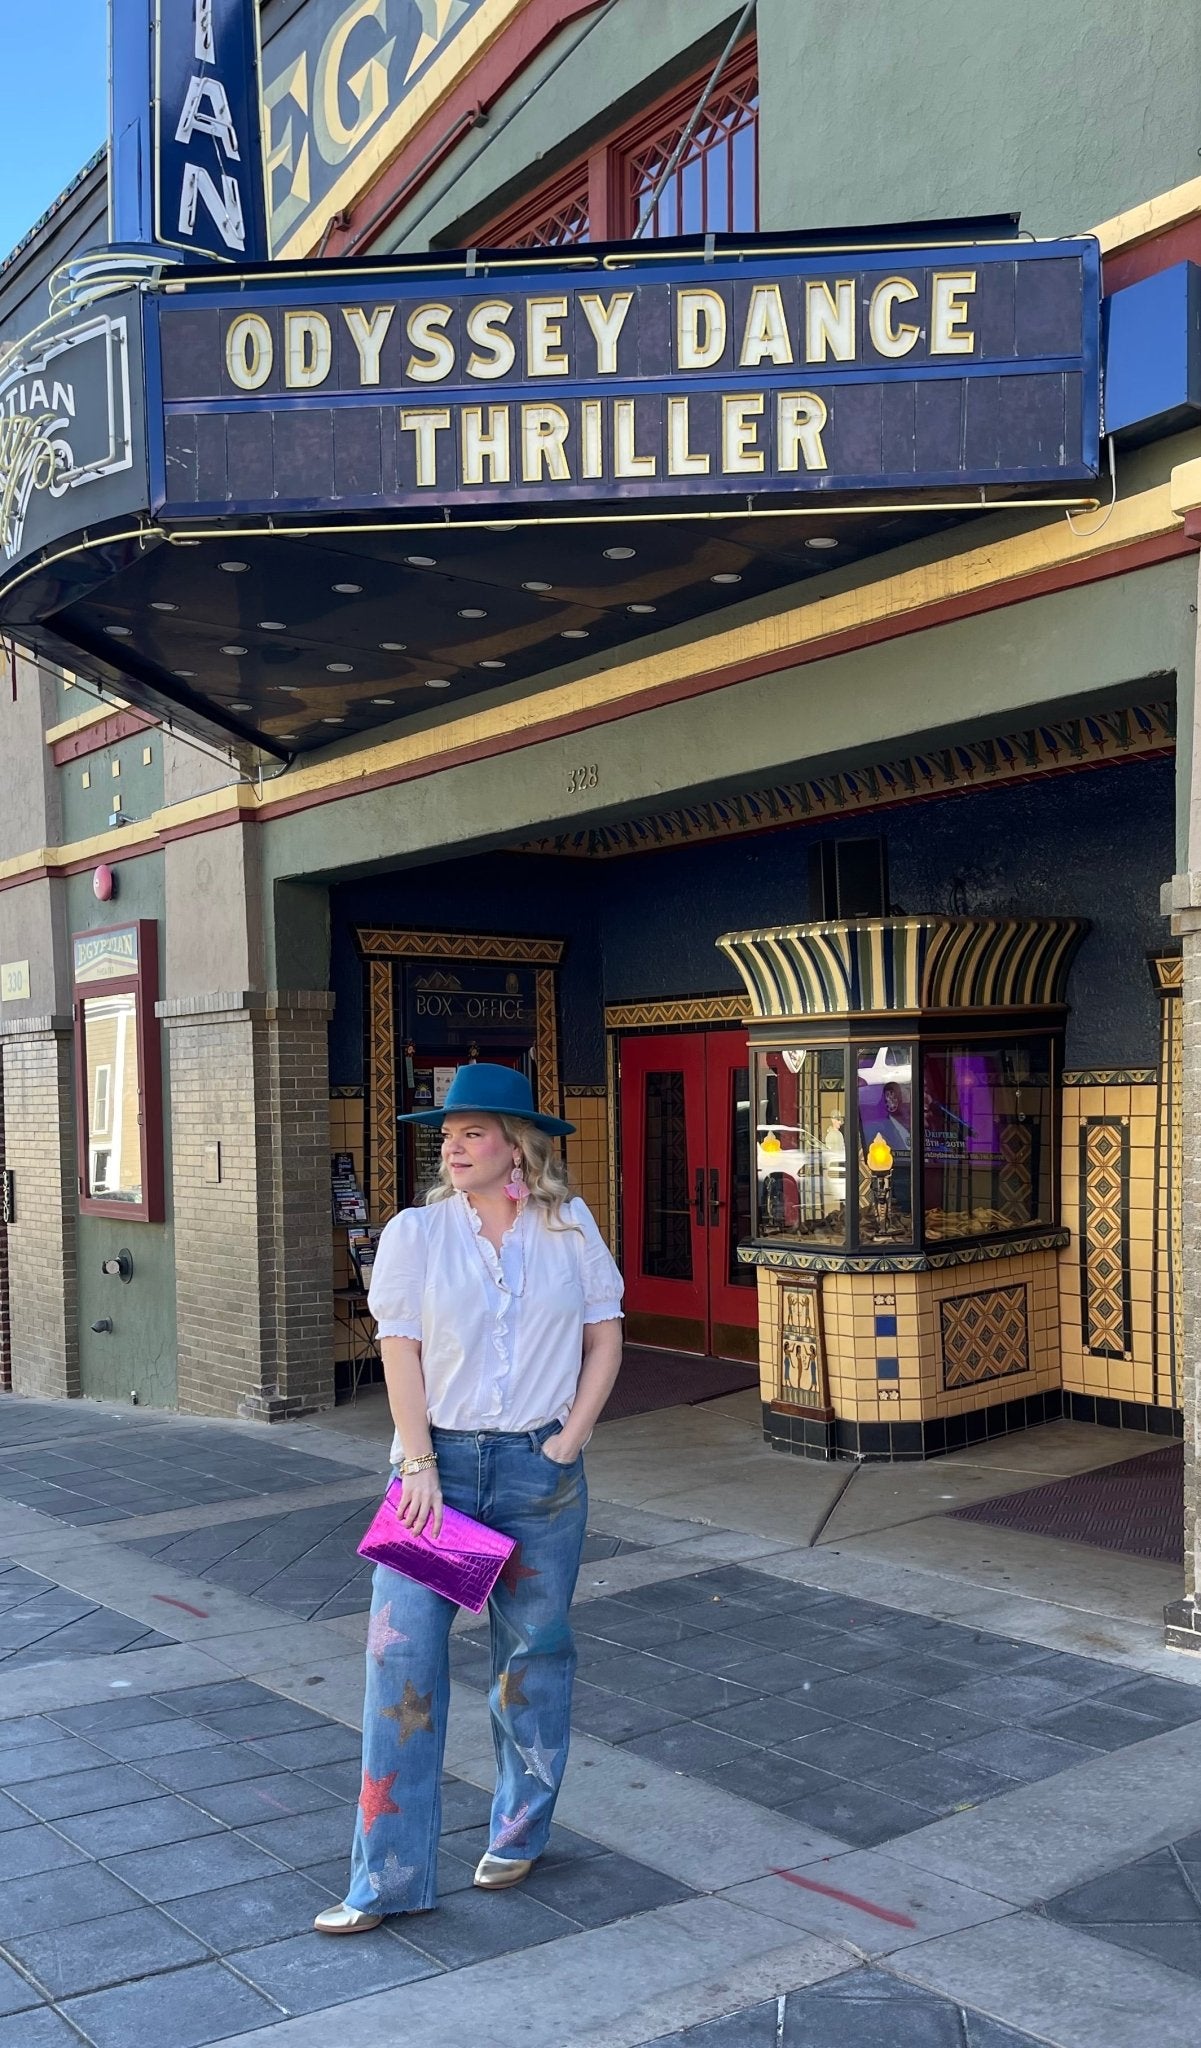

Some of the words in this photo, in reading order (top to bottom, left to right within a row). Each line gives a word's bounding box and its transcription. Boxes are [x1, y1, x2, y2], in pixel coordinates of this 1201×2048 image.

[226, 290, 634, 391] ODYSSEY
[676, 270, 977, 370] DANCE
[0, 379, 76, 421] TIAN
[400, 390, 828, 488] THRILLER
[566, 763, 599, 794] 328
[78, 934, 133, 966] EGYPTIAN
[8, 970, 23, 993] 330
[416, 994, 453, 1016] BOX
[466, 998, 525, 1020] OFFICE
